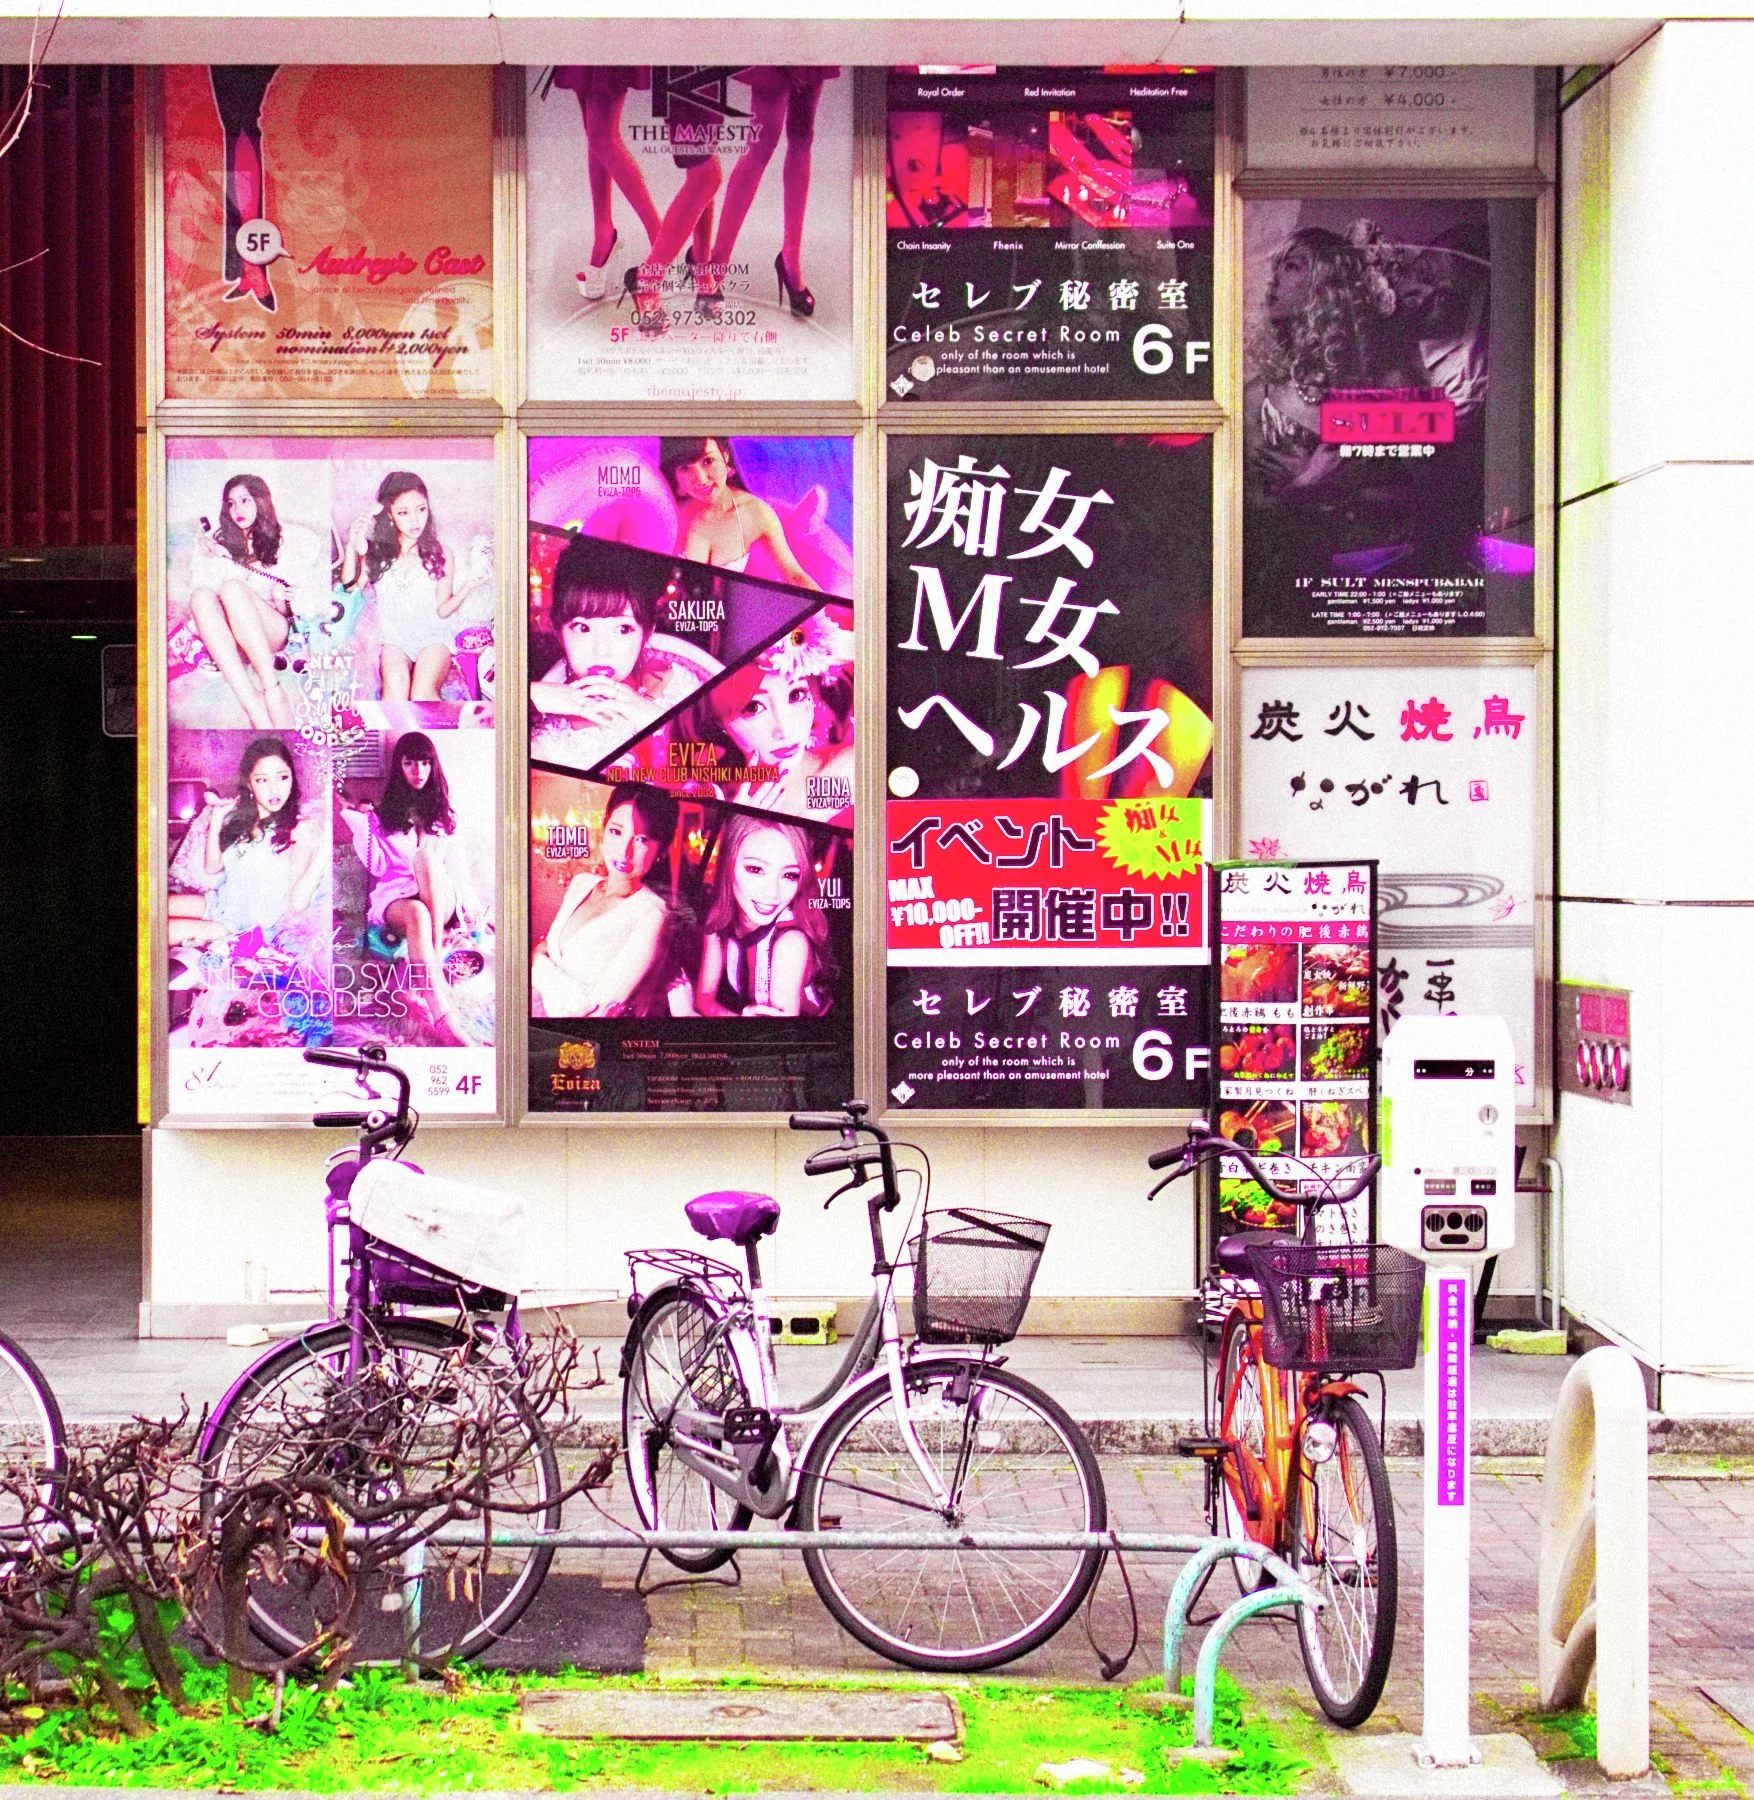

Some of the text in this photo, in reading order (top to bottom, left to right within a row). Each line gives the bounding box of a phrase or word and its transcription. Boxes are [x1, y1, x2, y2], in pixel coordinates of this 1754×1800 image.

[918, 88, 965, 98] Royal Order
[1024, 88, 1076, 97] Red Invitation
[1171, 86, 1188, 96] Free
[629, 124, 763, 143] THE MAJESTY
[642, 145, 657, 154] ALL
[734, 145, 749, 154] VIP
[247, 233, 271, 252] 5F
[897, 240, 952, 252] Chain Insanity
[993, 240, 1024, 250] Fhenix
[1055, 241, 1079, 250] Mirror
[1156, 240, 1195, 250] Suite One
[912, 278, 1188, 311] セレブ秘密室
[630, 310, 757, 326] 052-973-3302
[610, 327, 630, 343] 5F
[893, 325, 1120, 342] Celeb Secret Room
[941, 350, 1076, 362] only of the room which is
[1132, 323, 1211, 375] 6F
[936, 364, 980, 375] pleasant
[982, 364, 1005, 374] than
[1008, 365, 1021, 374] an
[1024, 365, 1081, 374] amusement
[1083, 363, 1110, 374] hotel
[1339, 444, 1436, 458] 朝7時まで営業中
[597, 465, 642, 486] MOMO
[901, 454, 1114, 569] 痴女
[1295, 577, 1313, 588] 1F
[1321, 577, 1367, 588] SULT
[668, 600, 725, 620] SAKURA
[897, 563, 1121, 679] M女
[1250, 693, 1526, 742] 炭火焼鳥
[897, 690, 1175, 789] ヘルス
[669, 742, 718, 767] EVIZA
[659, 767, 688, 783] CLUB
[691, 767, 731, 783] NISHIKI
[734, 767, 780, 783] NAGOYA
[806, 776, 851, 798] RIONA
[1290, 770, 1449, 811] ながれ
[547, 826, 588, 847] TOMO
[890, 814, 1096, 869] イベント
[817, 878, 842, 898] YUI
[887, 875, 935, 903] MAX
[1221, 869, 1367, 896] 炭火焼鳥
[991, 886, 1191, 941] 開催中!!
[939, 921, 991, 949] OFF!!
[1221, 924, 1369, 940] こだわりの肥後赤鶏
[257, 989, 409, 1018] GODDESS
[912, 985, 1188, 1018] セレブ秘密室
[622, 1039, 659, 1049] SYSTEM
[894, 1031, 1120, 1049] Celeb Secret Room
[941, 1055, 1076, 1067] only of the room which is
[1132, 1029, 1211, 1081] 6F
[429, 1064, 448, 1075] 052
[908, 1069, 1110, 1082] more pleasant than an amusement hotel
[1463, 1066, 1476, 1077] 分
[430, 1075, 448, 1086] 962
[455, 1075, 482, 1095] 4F
[427, 1086, 450, 1097] 5599
